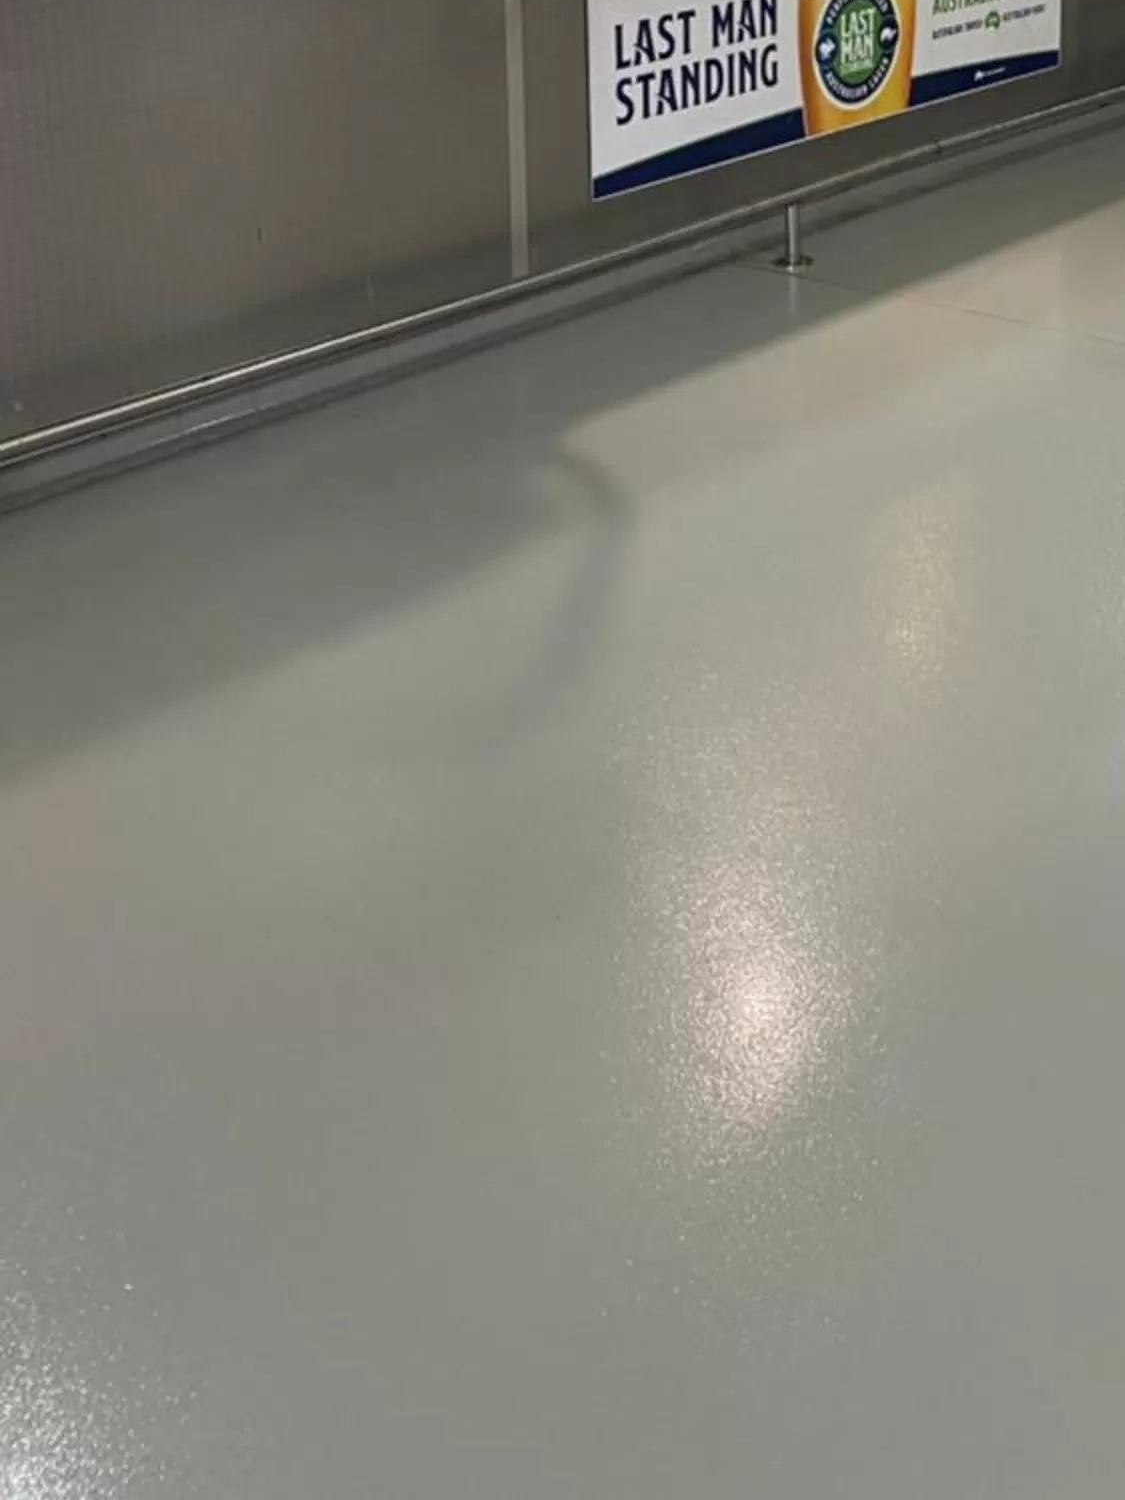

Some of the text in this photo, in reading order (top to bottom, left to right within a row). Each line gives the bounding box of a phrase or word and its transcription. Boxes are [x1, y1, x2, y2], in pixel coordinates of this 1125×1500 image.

[614, 8, 696, 70] LAST
[841, 7, 876, 37] LAST
[841, 34, 875, 64] MAN
[615, 43, 779, 126] STANDING
